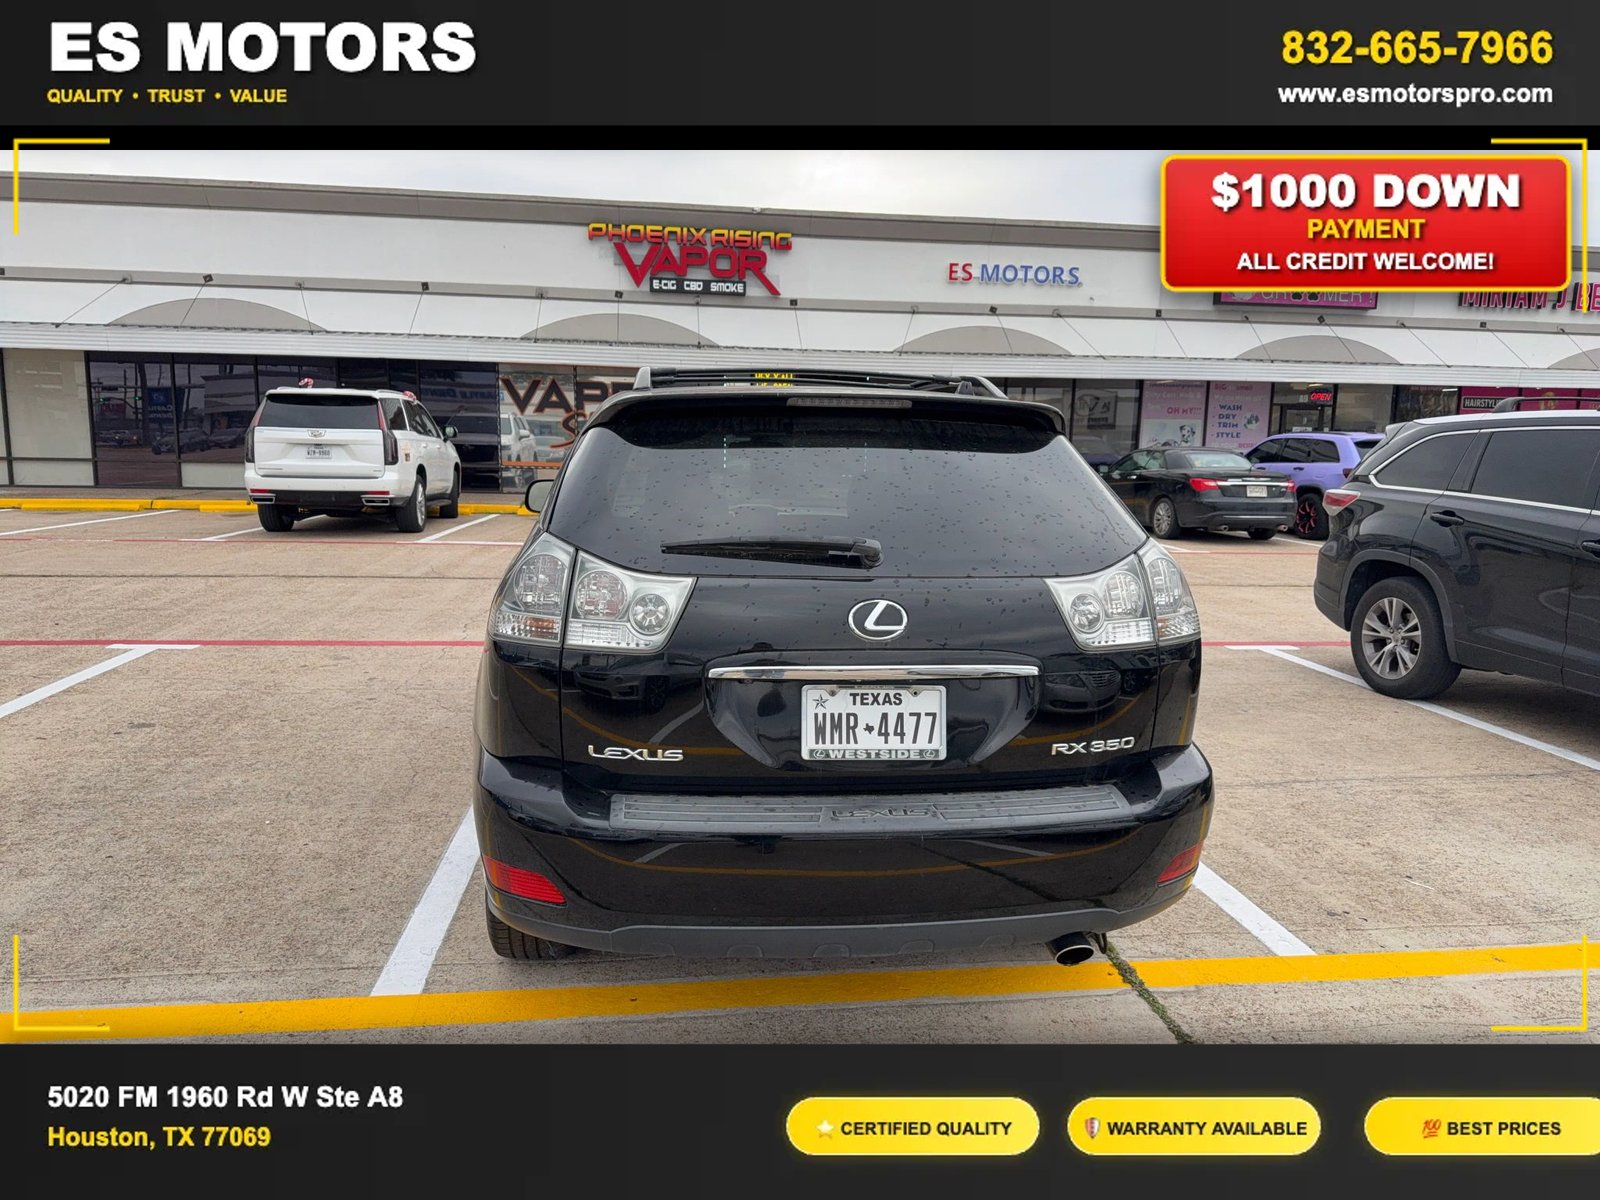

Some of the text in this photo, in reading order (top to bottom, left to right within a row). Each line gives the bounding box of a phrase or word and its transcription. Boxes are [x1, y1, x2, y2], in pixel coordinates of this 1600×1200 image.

[588, 223, 792, 250] PHOENIX RISING
[613, 242, 781, 296] VAPOR
[948, 263, 1079, 285] ES MOTORS
[652, 279, 744, 293] E-CIG CBD SMOKE
[1311, 392, 1332, 401] OPEN
[1167, 406, 1180, 415] OH
[850, 693, 903, 706] TEXAS
[1051, 736, 1135, 756] RX 350
[588, 745, 684, 762] LEXUS
[829, 750, 921, 760] WESTSIDE
[831, 809, 930, 819] LEXUS
